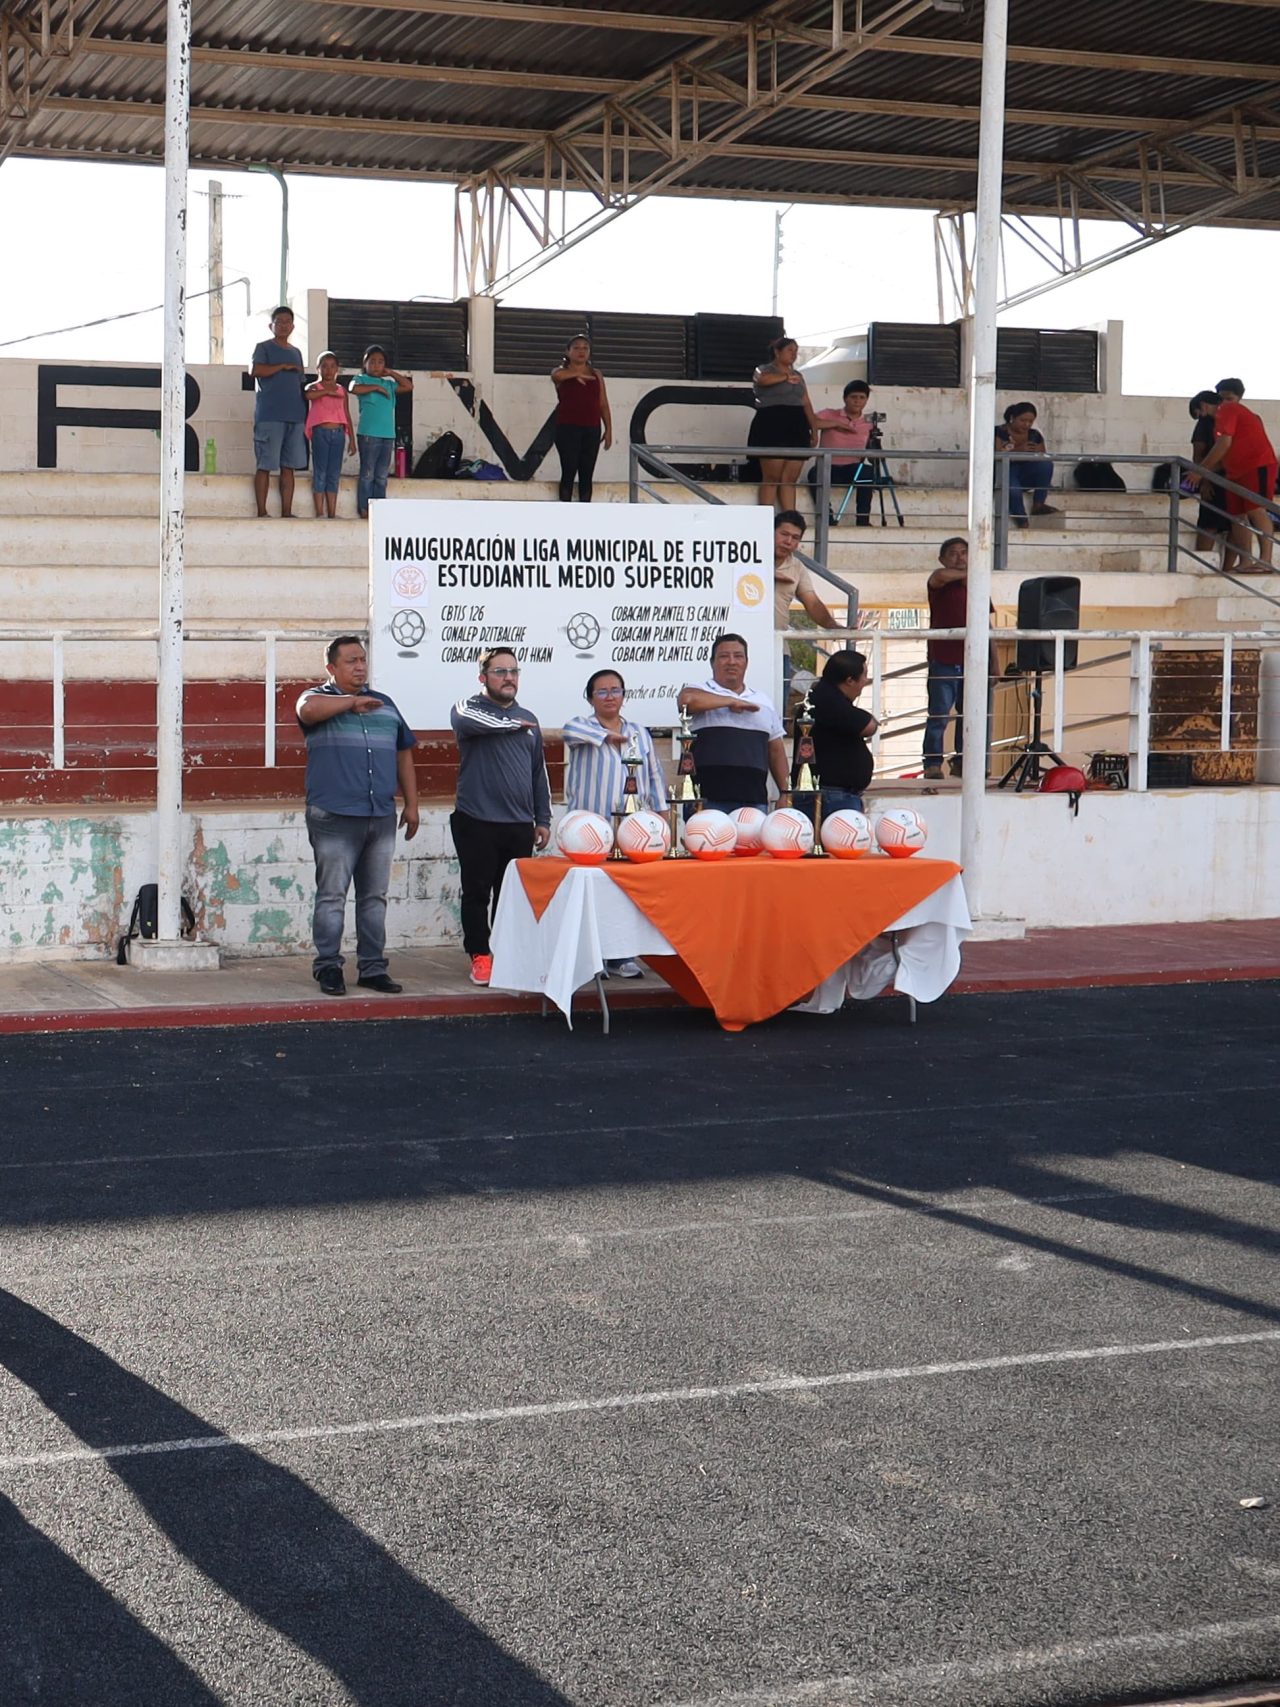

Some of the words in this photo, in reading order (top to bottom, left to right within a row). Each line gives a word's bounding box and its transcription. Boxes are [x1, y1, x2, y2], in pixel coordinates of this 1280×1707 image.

[385, 534, 516, 561] INAUGURACIÓN
[523, 538, 560, 562] LIGA
[566, 539, 658, 563] MUNICIPAL
[664, 541, 684, 562] DE
[693, 541, 762, 563] FUTBOL
[437, 564, 551, 588] ESTUDIANTIL
[558, 565, 615, 588] MEDIO
[624, 566, 714, 589] SUPERIOR
[441, 605, 467, 621] CBTIS
[469, 605, 485, 621] 126
[611, 606, 651, 621] COBACAM
[651, 606, 685, 621] PLANTEL
[686, 606, 696, 621] 13
[441, 626, 478, 641] CONALEP
[611, 626, 652, 641] COBACAM
[653, 626, 688, 641] PLANTEL
[690, 626, 699, 641] 11
[441, 647, 482, 662] COBACAM
[518, 647, 529, 661] 01
[611, 646, 655, 661] COBACAM
[657, 646, 693, 661] PLANTEL
[696, 646, 710, 661] 08
